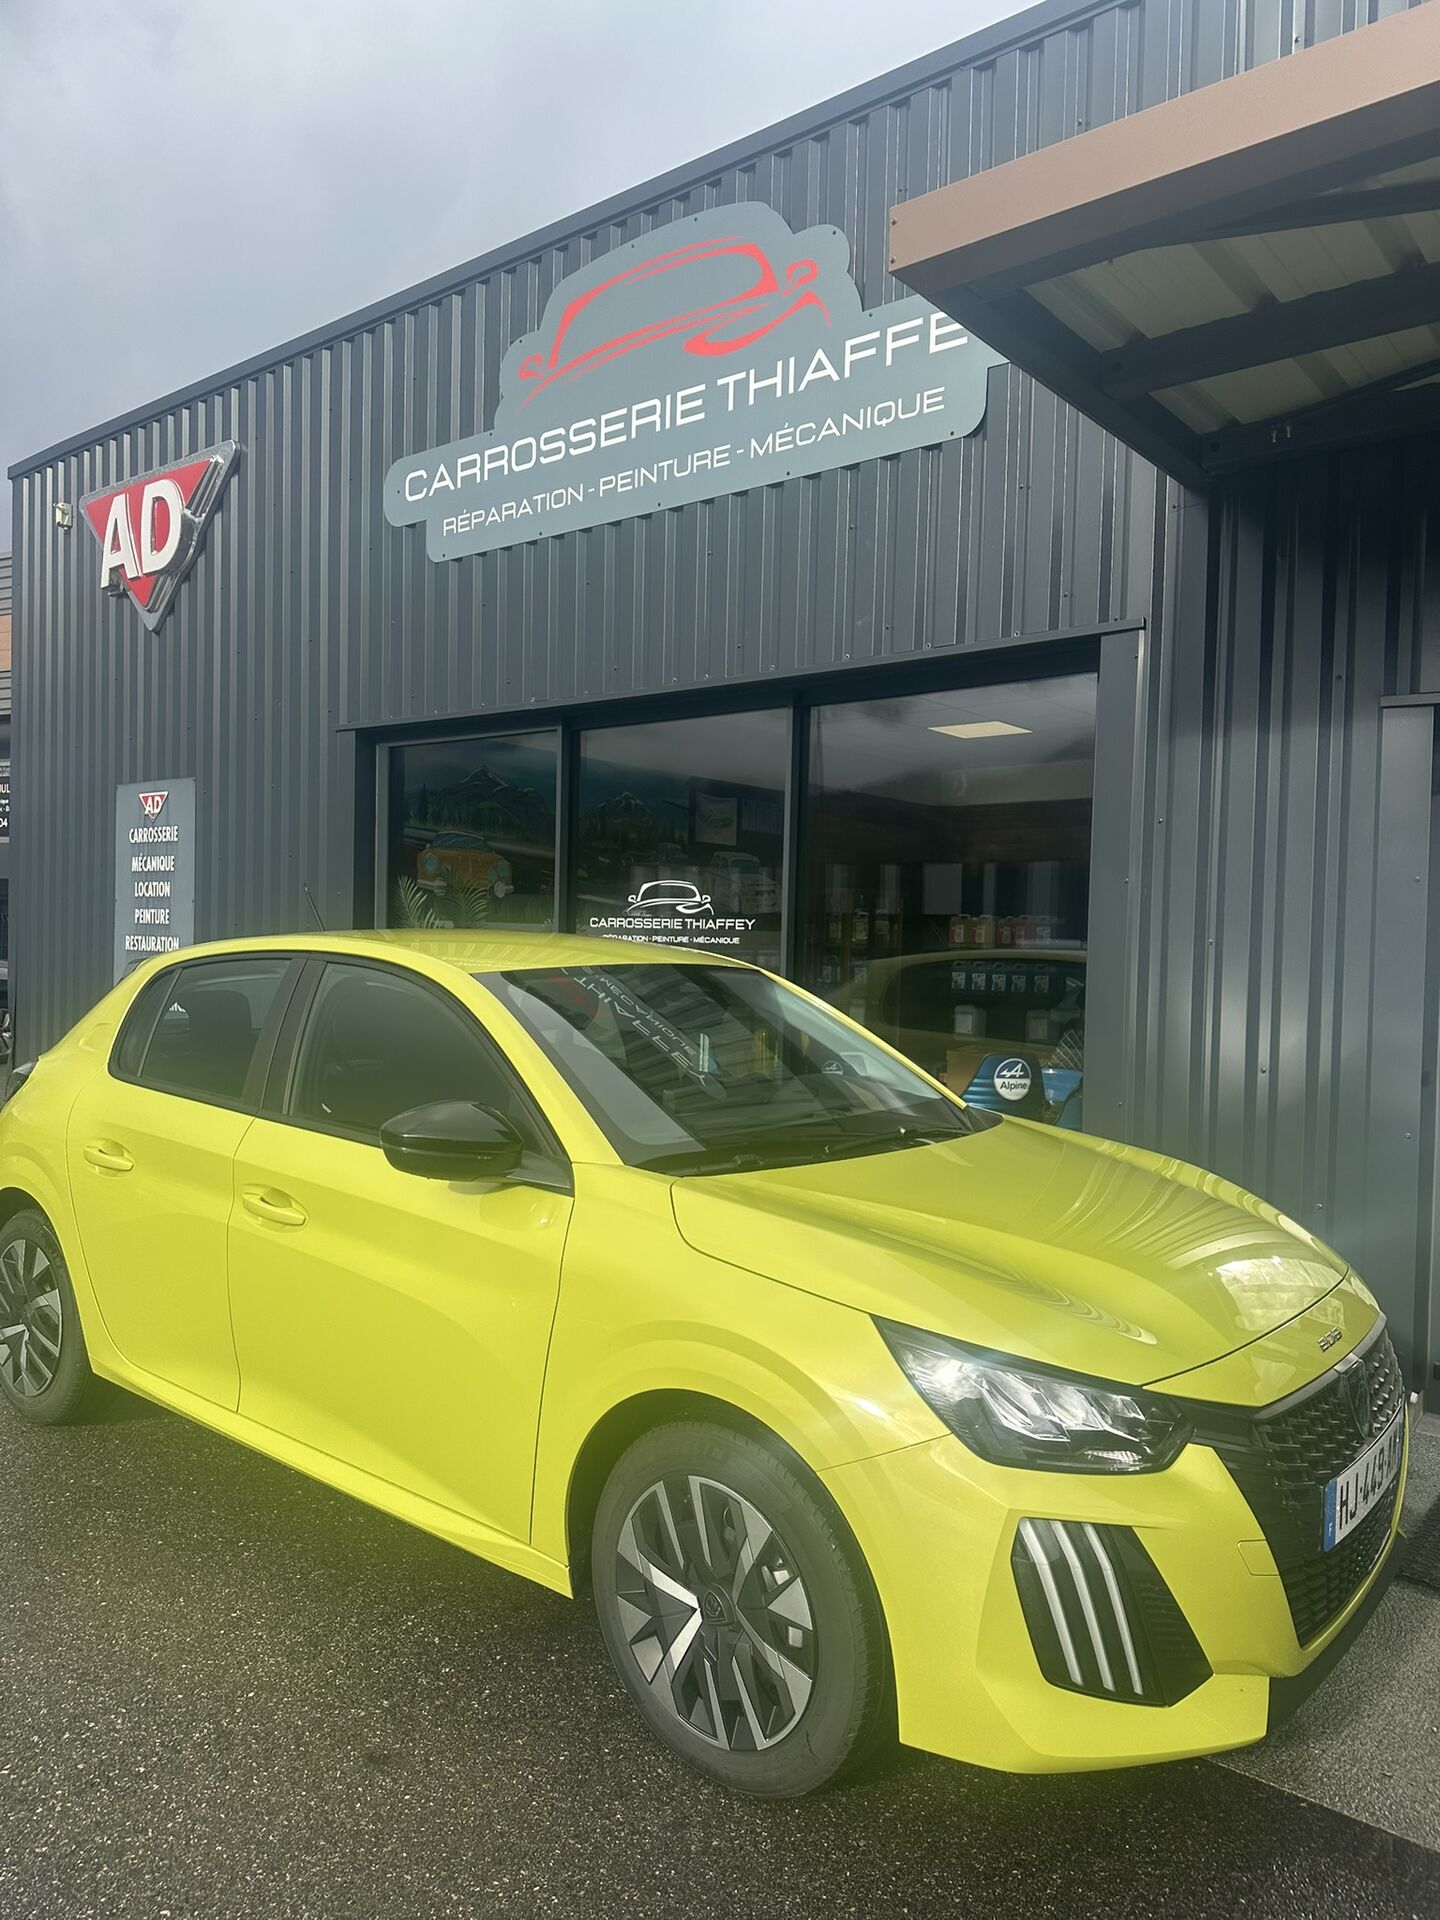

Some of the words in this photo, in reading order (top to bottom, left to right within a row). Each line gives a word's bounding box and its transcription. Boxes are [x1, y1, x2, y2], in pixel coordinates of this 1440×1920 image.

[404, 383, 706, 502] CARROSSERIE
[716, 311, 968, 412] THIAFFE
[443, 484, 584, 537] RÉPARATION
[599, 444, 731, 498] PEINTURE
[750, 386, 945, 460] MÉCANIQUE
[100, 478, 184, 588] AD
[144, 795, 163, 815] AD
[129, 825, 178, 844] CARROSSERIE
[131, 853, 175, 872] MÉCANIQUE
[134, 881, 171, 898] LOCATION
[134, 908, 170, 925] PEINTURE
[589, 917, 683, 929] CARROSSERIE
[685, 918, 756, 930] THIAFFEY
[125, 935, 180, 952] RESTAURATION
[652, 936, 689, 944] PEINTURE
[1000, 1081, 1027, 1091] Alpine
